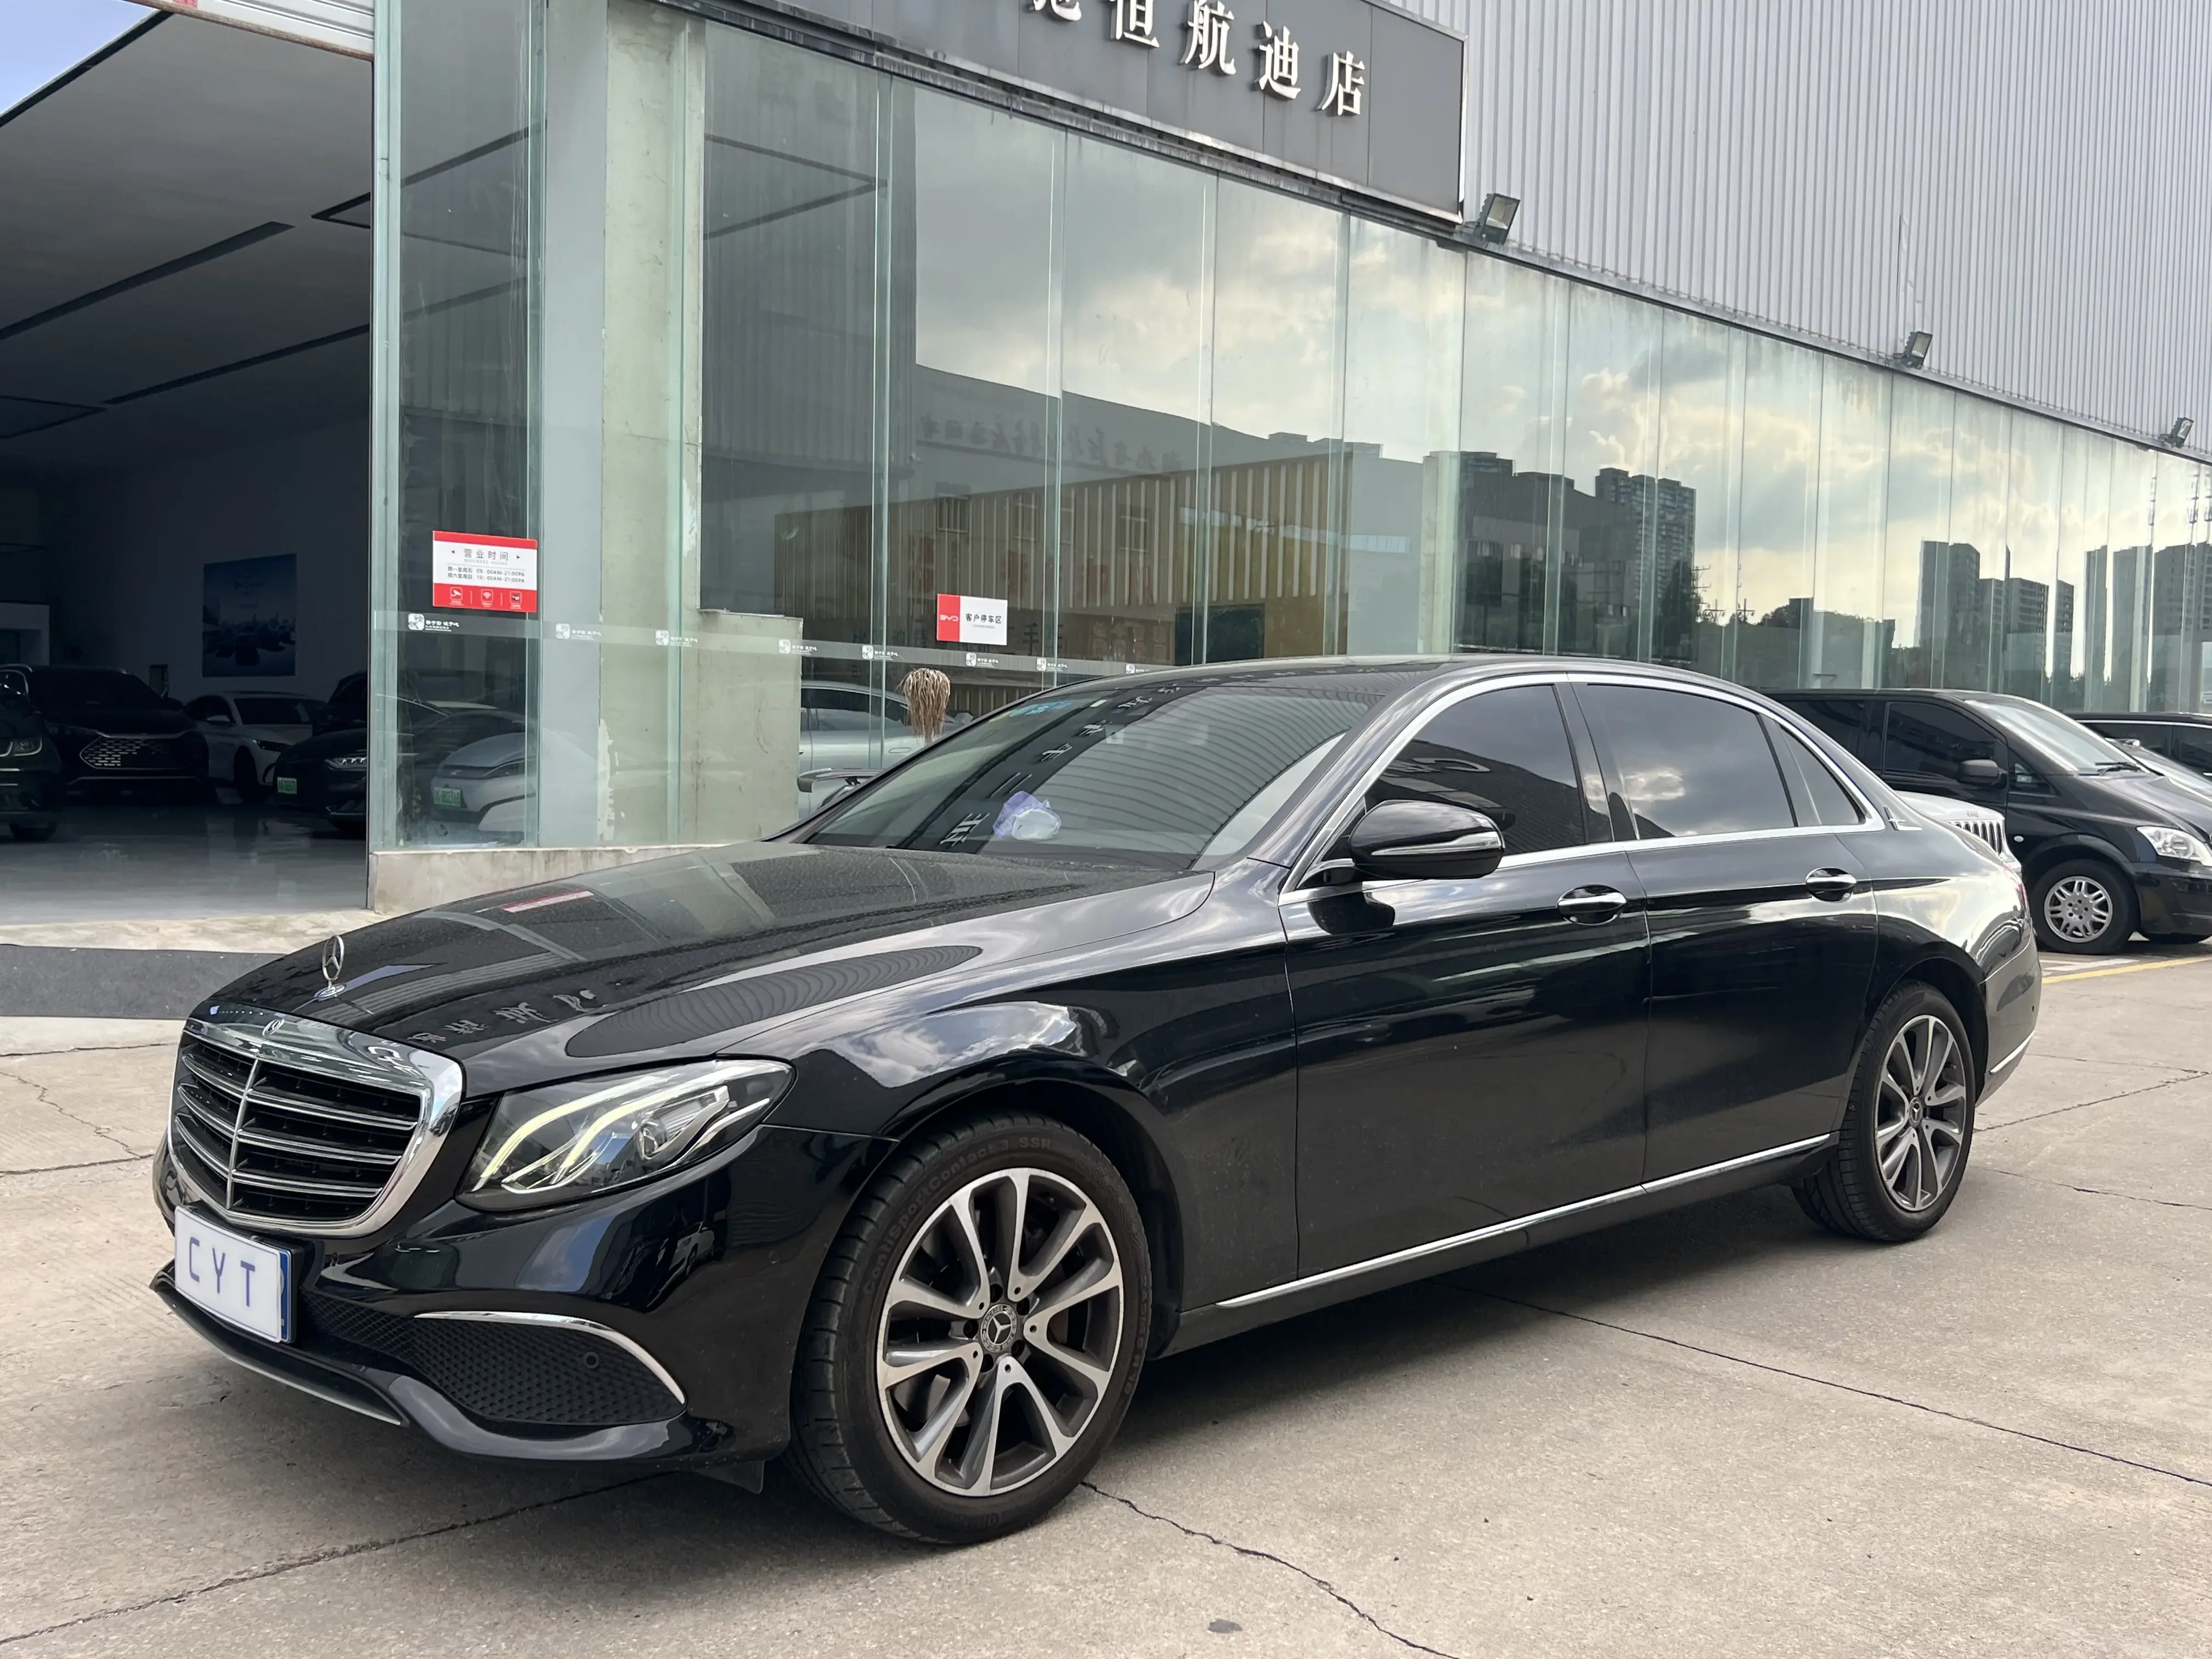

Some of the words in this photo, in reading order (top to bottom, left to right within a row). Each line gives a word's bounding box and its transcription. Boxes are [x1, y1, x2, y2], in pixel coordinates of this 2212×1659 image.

[464, 549, 508, 561] 营业时间
[966, 613, 1002, 624] 客户停车区
[863, 1144, 994, 1295] ContiSportContact
[1018, 1136, 1052, 1150] SSR
